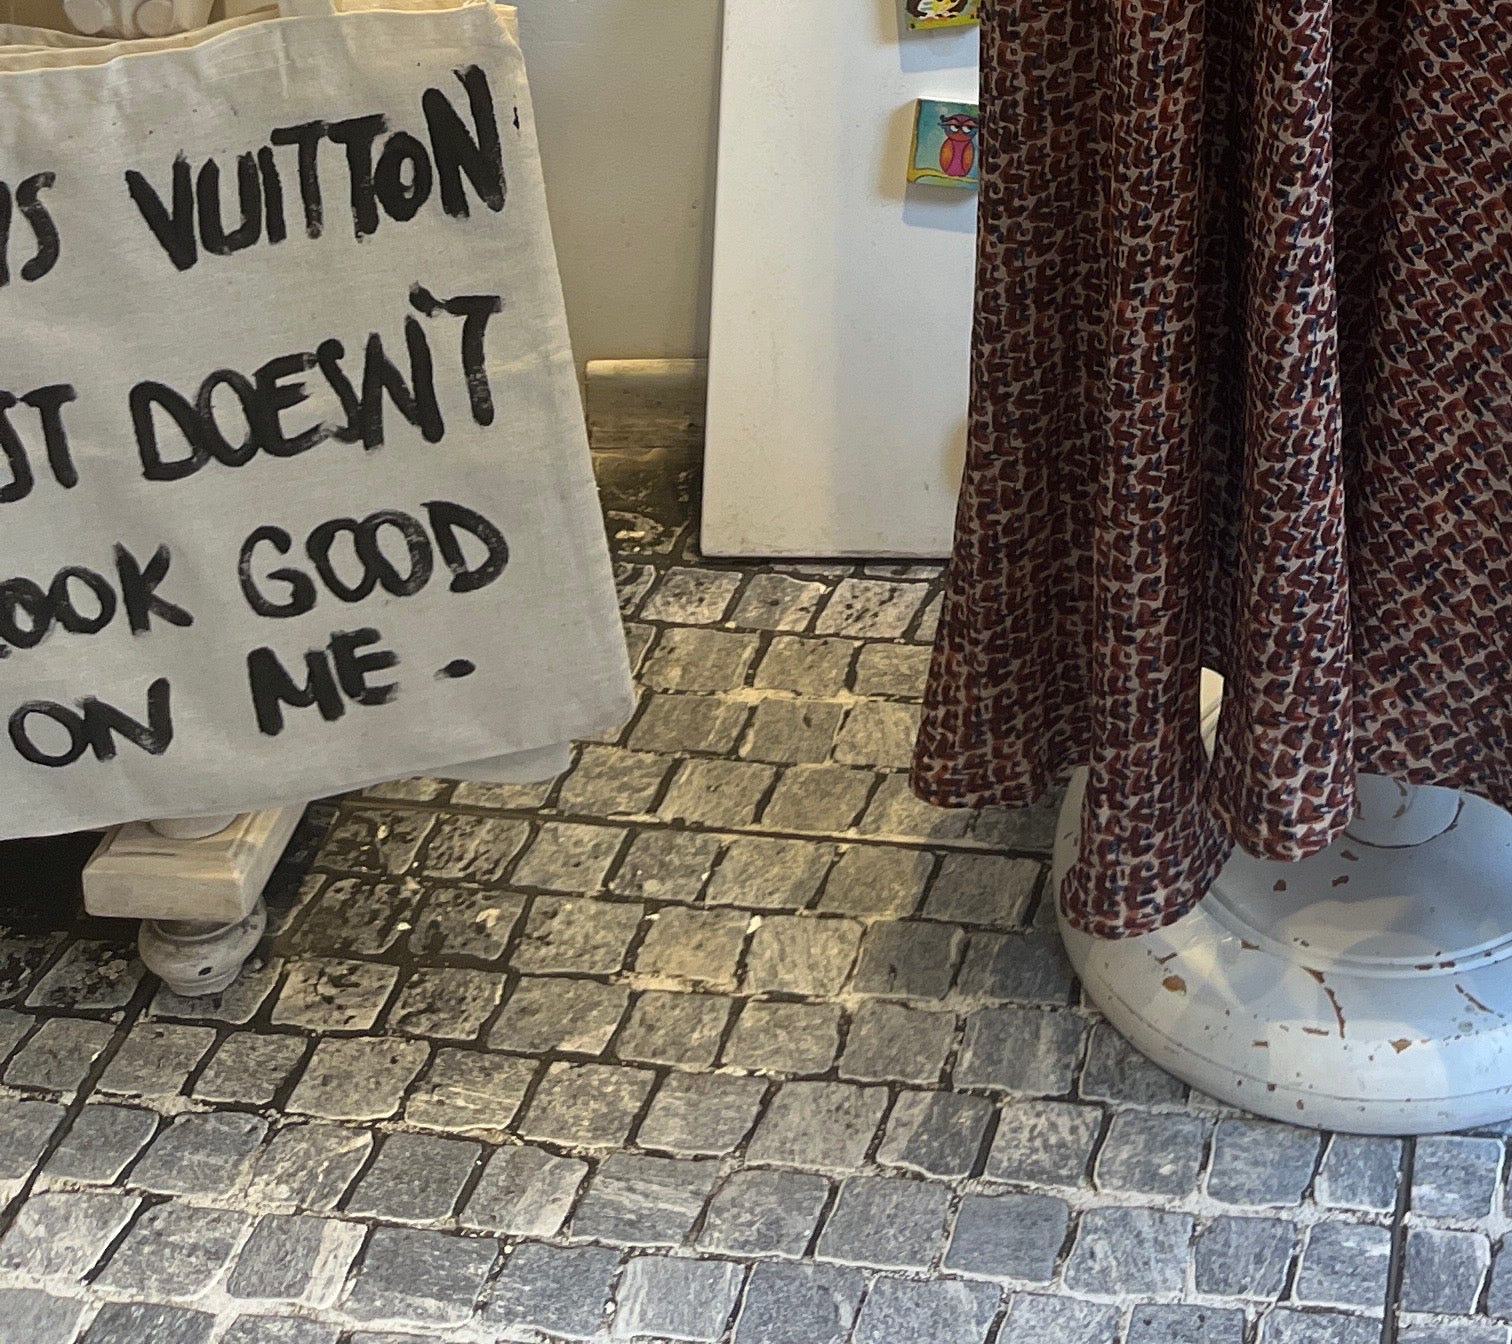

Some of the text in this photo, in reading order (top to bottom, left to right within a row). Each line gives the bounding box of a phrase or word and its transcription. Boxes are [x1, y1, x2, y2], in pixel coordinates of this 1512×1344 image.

[124, 64, 507, 272] VUITTON
[129, 281, 503, 482] DOESN'T
[238, 500, 509, 620] GOOD
[8, 676, 173, 768] ON
